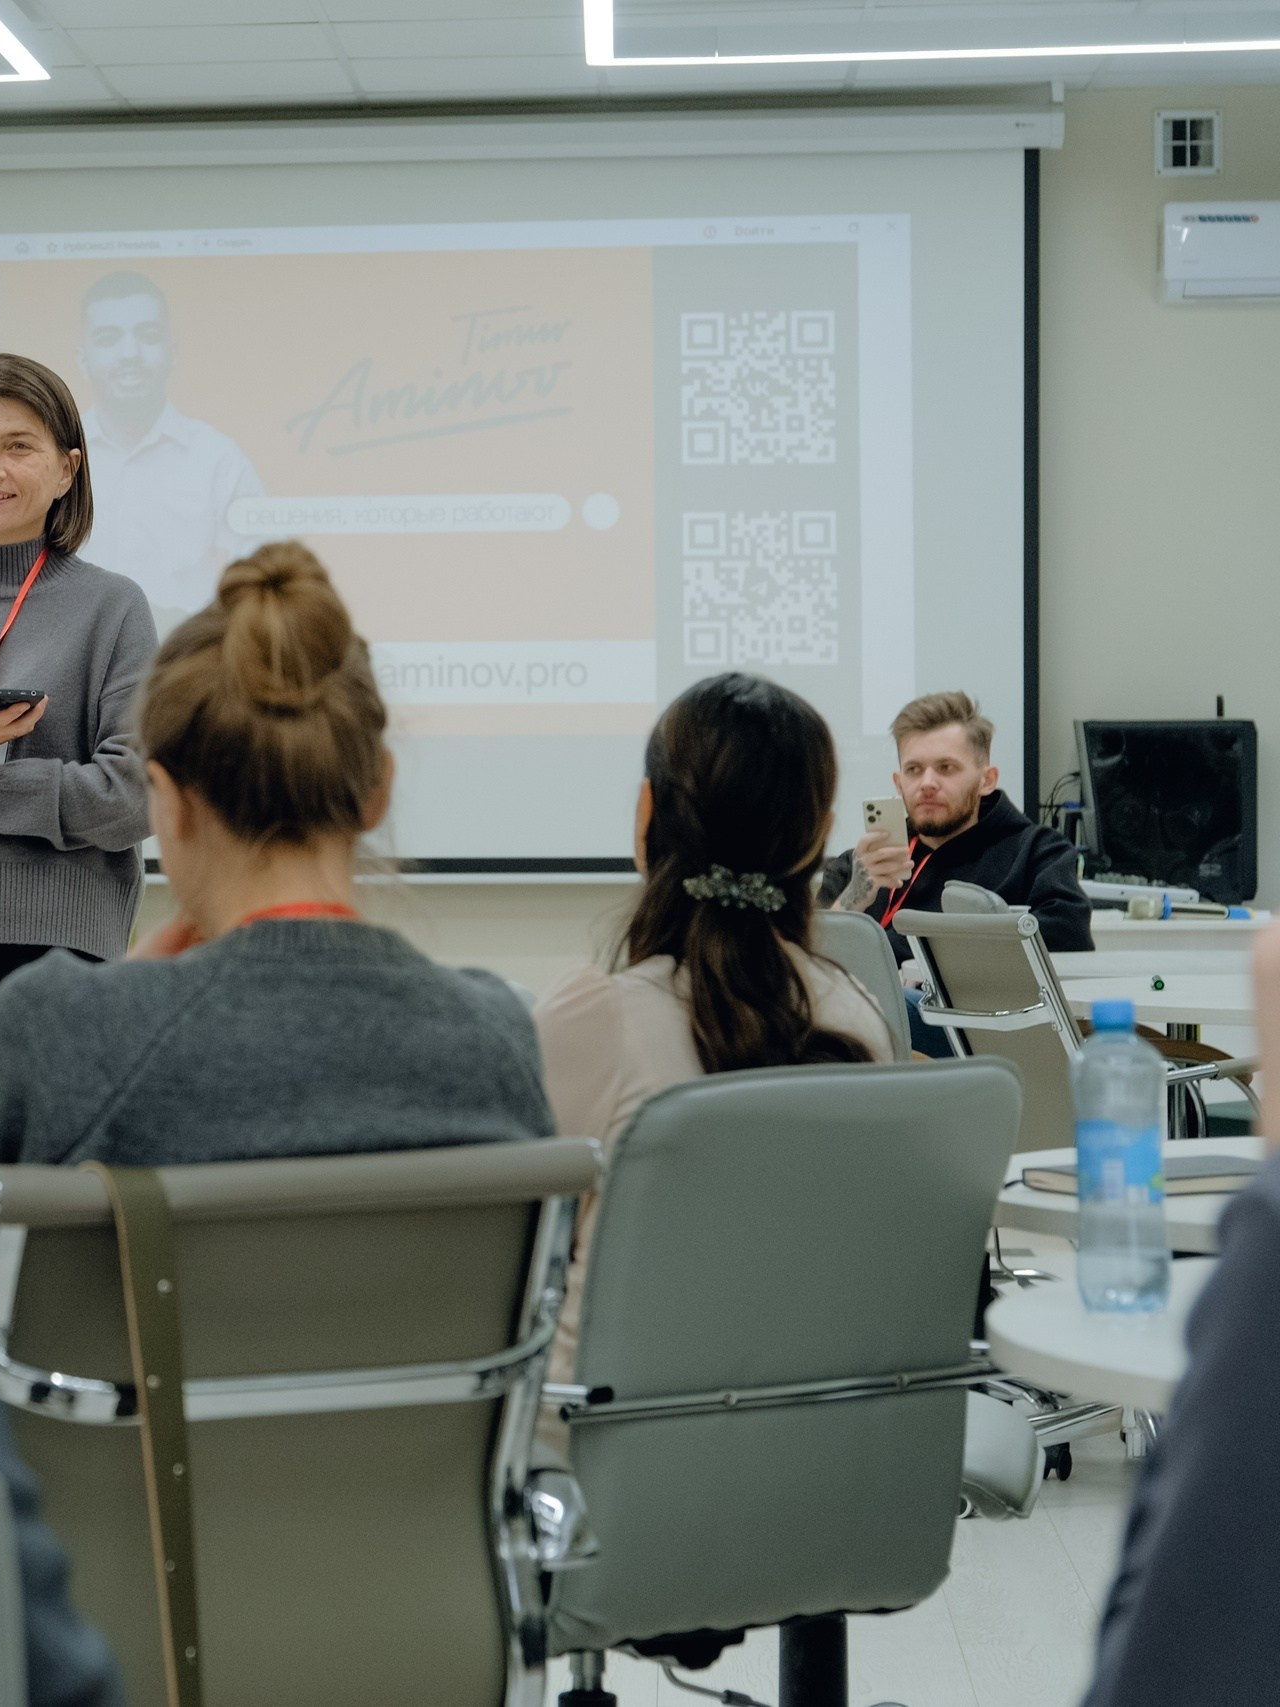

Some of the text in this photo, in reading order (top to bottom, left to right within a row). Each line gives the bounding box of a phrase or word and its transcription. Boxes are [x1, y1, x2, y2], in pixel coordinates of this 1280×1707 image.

[449, 304, 574, 367] Timur
[285, 356, 574, 455] Aminov
[245, 502, 554, 529] решения, которые работают
[379, 655, 588, 695] aminov.pro
